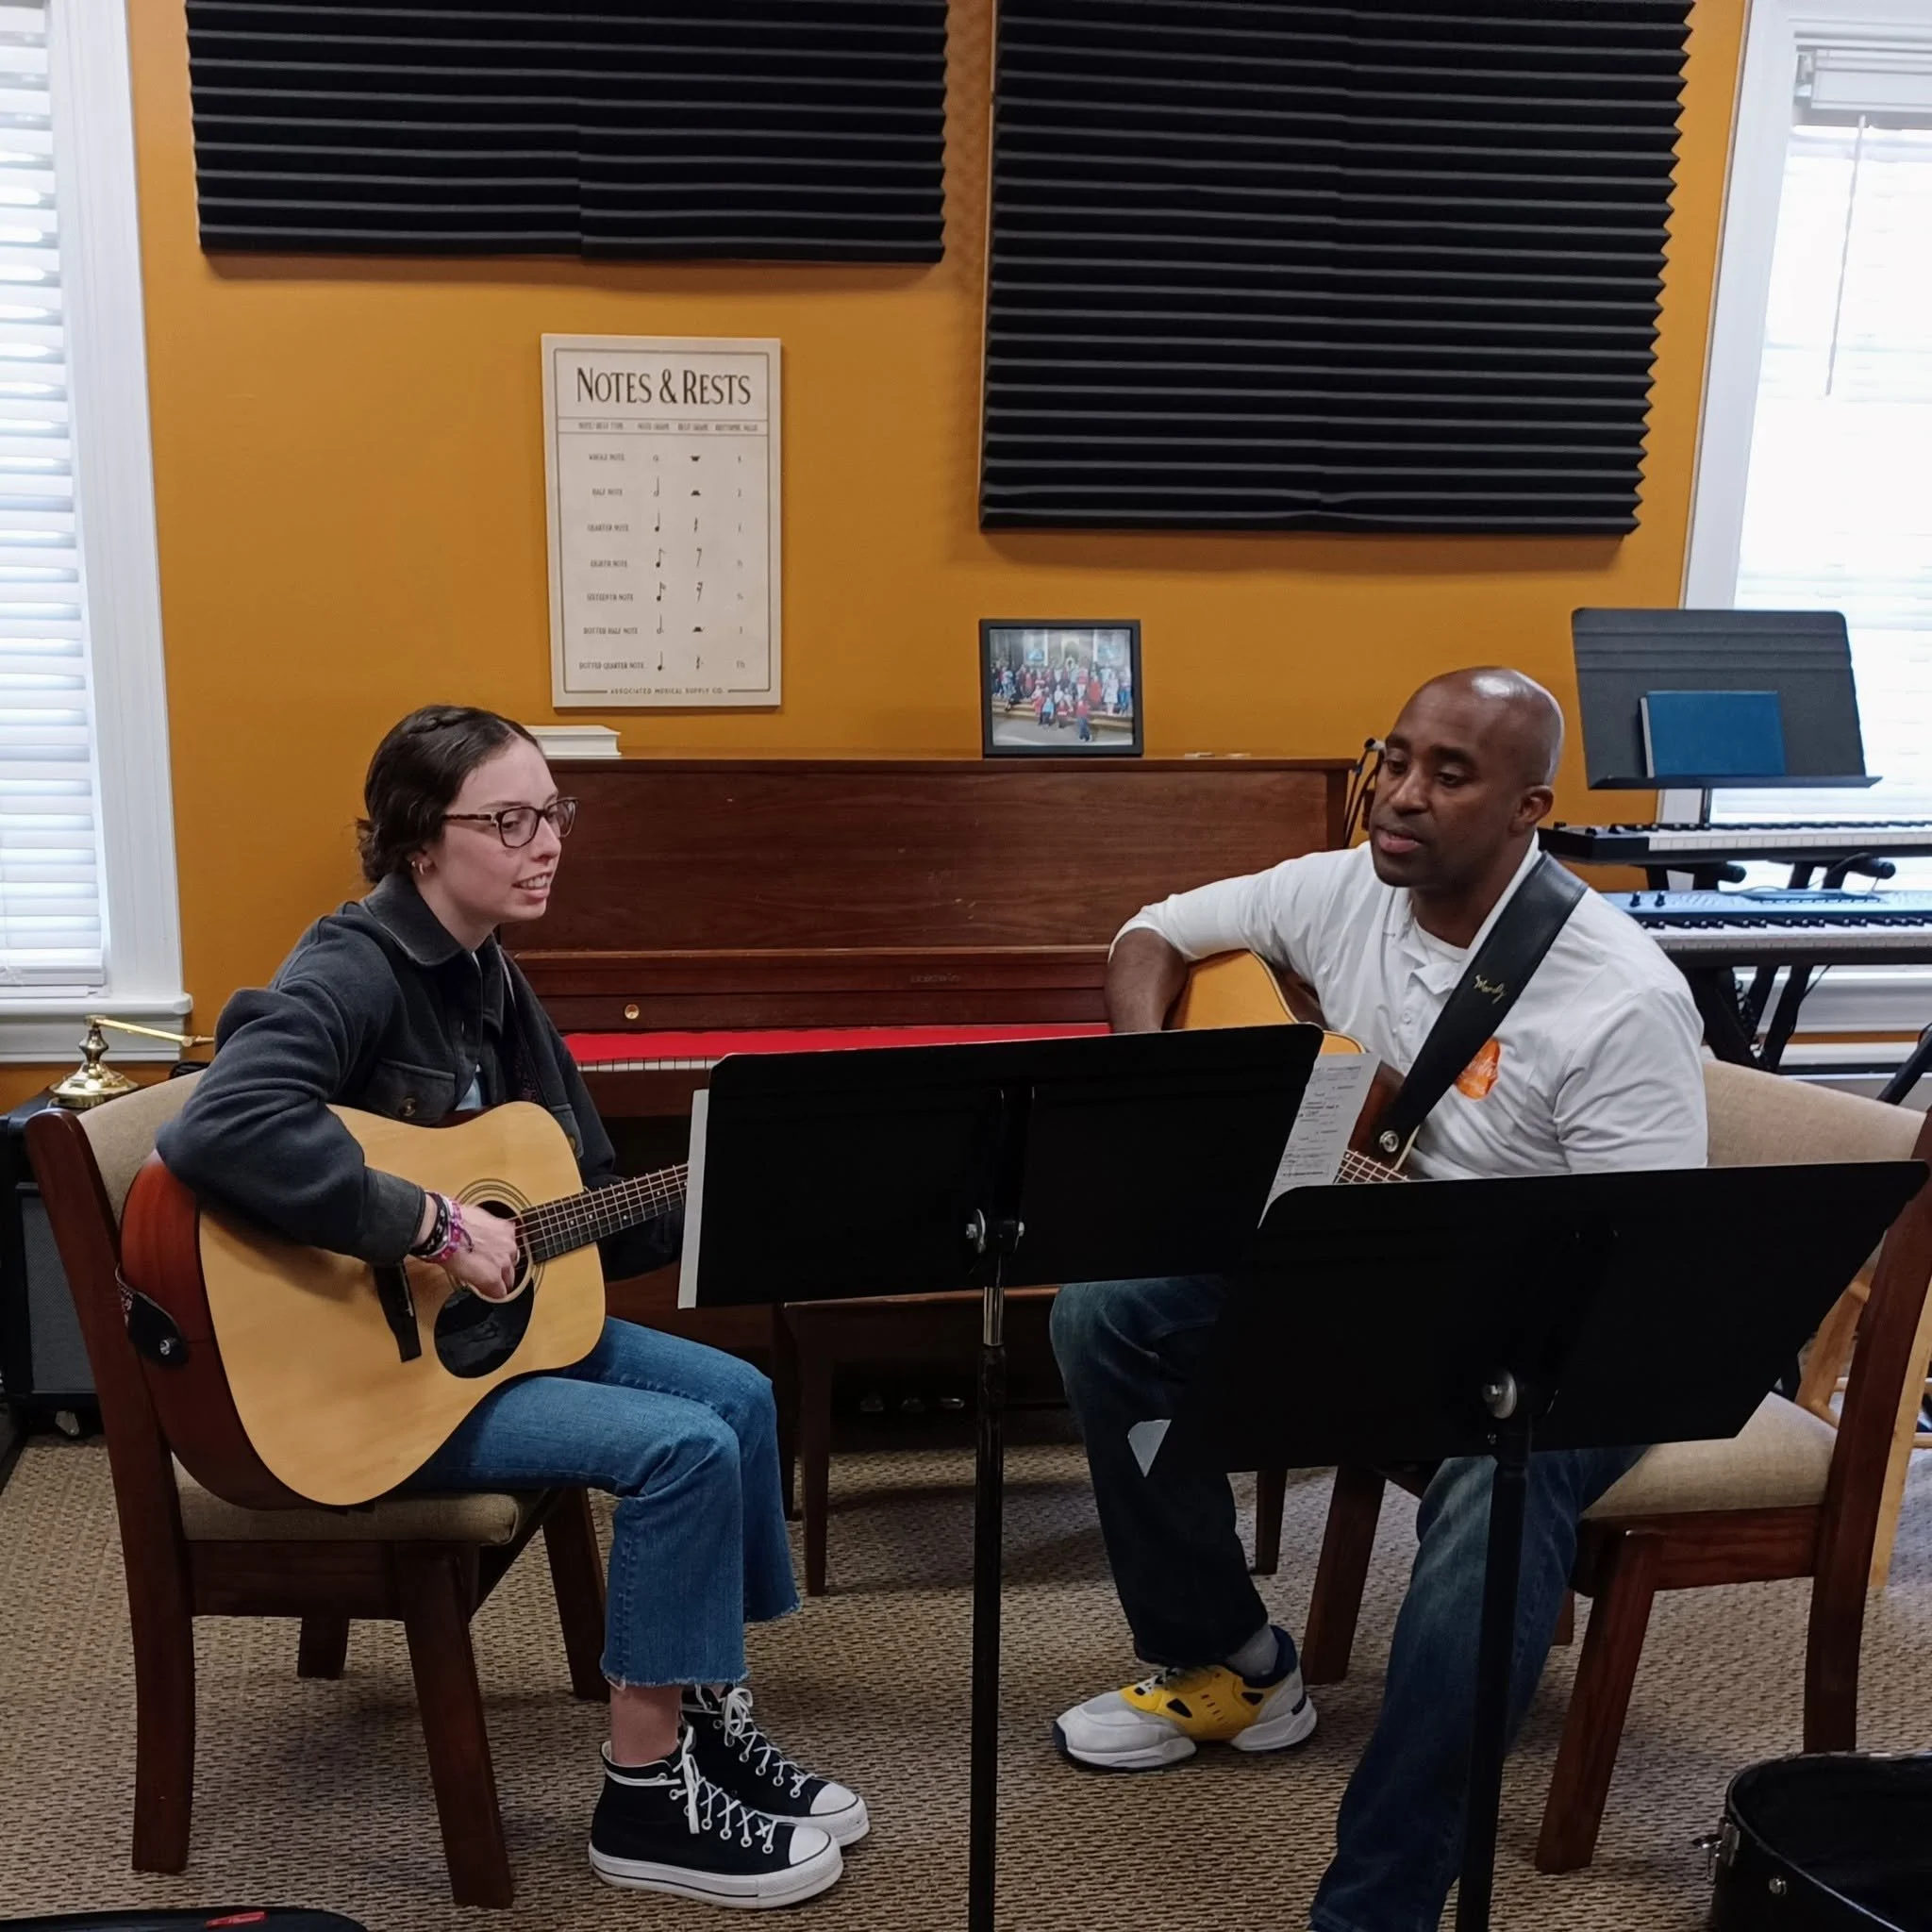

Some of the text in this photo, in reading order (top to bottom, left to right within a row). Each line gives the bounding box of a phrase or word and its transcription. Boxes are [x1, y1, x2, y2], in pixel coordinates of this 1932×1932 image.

[577, 368, 751, 405] NOTES & RESTS
